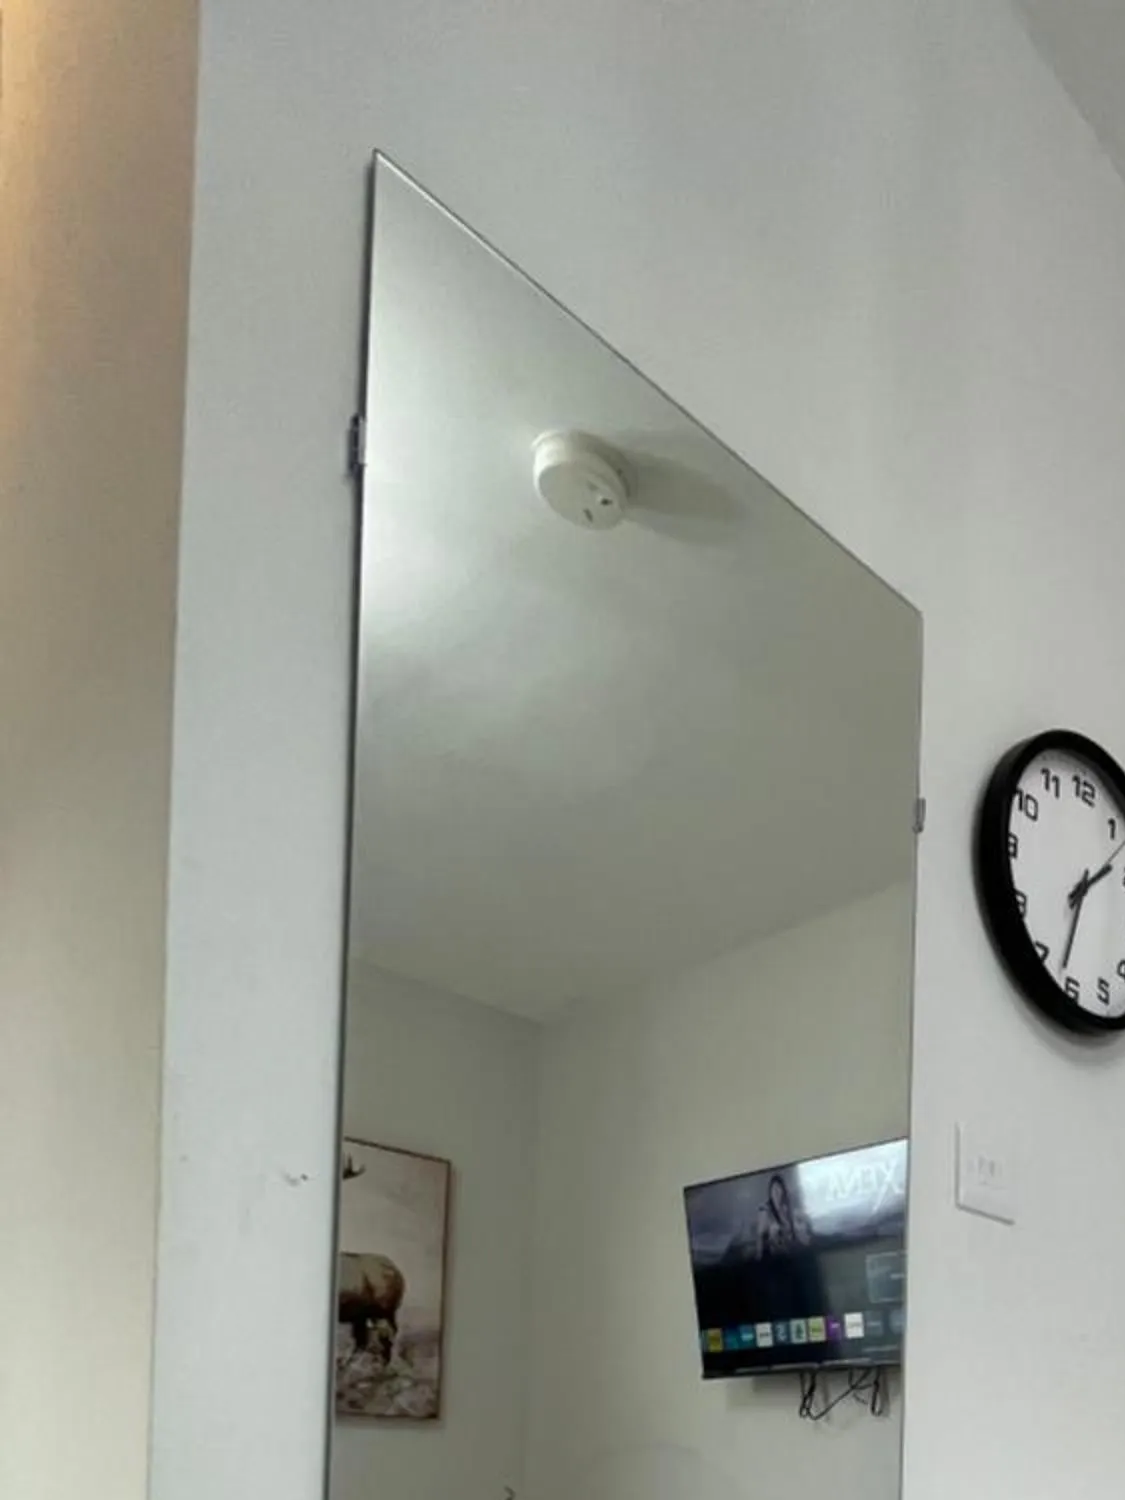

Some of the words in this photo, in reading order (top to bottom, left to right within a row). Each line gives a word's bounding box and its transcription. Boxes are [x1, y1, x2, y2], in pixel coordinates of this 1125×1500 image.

[1040, 767, 1060, 799] 11
[1072, 774, 1095, 808] 12
[1014, 787, 1038, 822] 10
[1107, 818, 1116, 840] 1
[1034, 940, 1049, 963] 7
[1063, 975, 1080, 1002] 6
[1097, 976, 1110, 1006] 5
